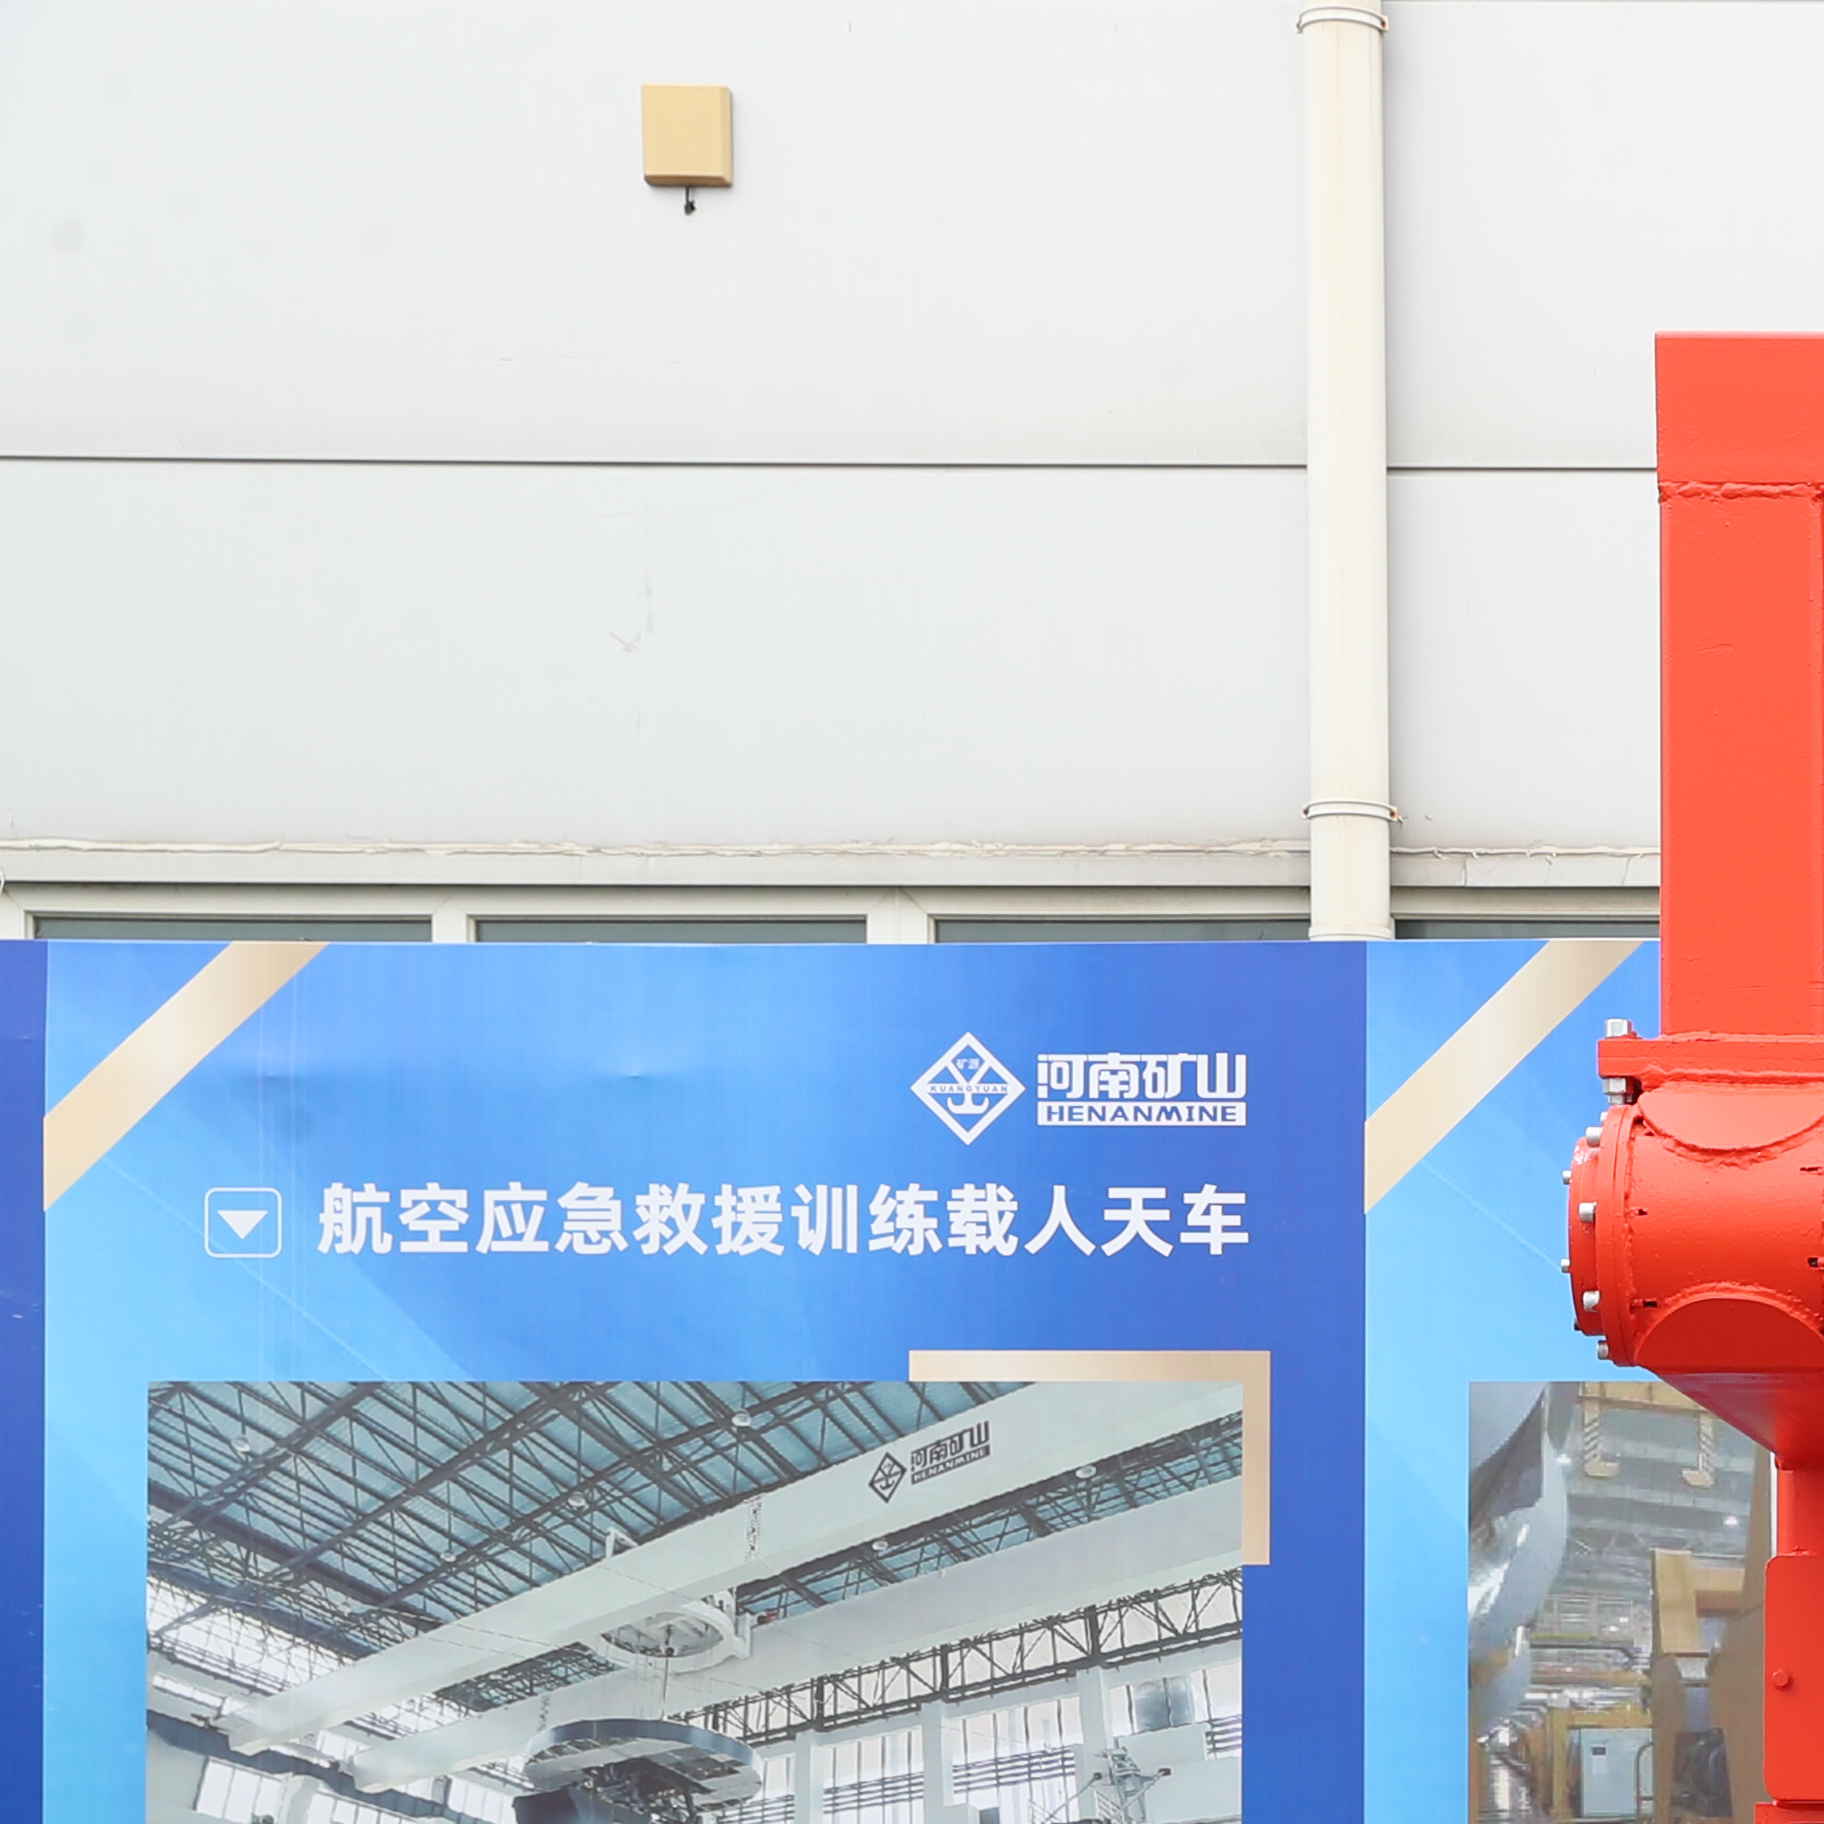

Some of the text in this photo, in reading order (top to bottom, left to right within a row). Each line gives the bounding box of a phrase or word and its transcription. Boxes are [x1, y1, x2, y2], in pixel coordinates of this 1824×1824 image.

[1038, 1052, 1247, 1099] 河南矿山
[1046, 1105, 1238, 1122] HENANMINE
[316, 1181, 1249, 1258] 航空应急救援训练载人天车
